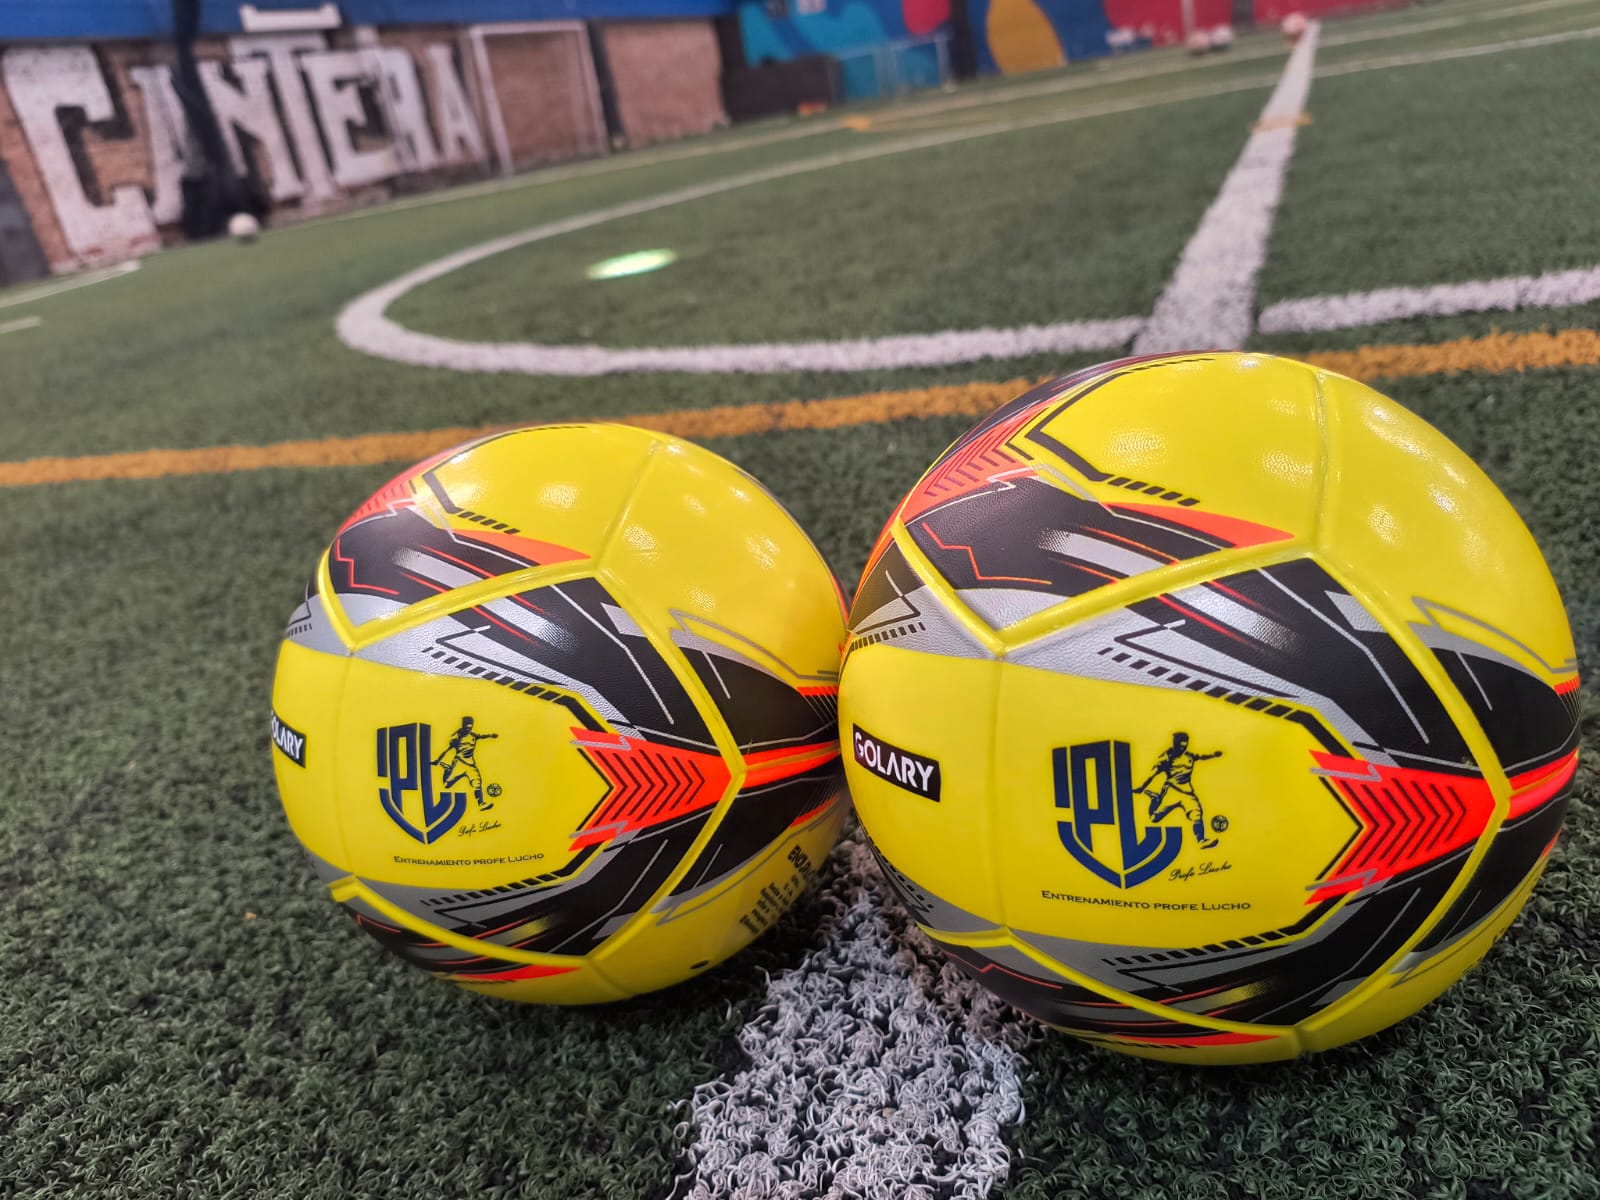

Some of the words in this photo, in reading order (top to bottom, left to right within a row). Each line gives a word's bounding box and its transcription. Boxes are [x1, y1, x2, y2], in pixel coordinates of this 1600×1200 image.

[271, 711, 304, 760] OLARY
[854, 731, 935, 792] GOLARY
[1197, 860, 1233, 876] Lucho
[1152, 902, 1199, 911] PROFE
[1200, 901, 1252, 911] LUCHO
